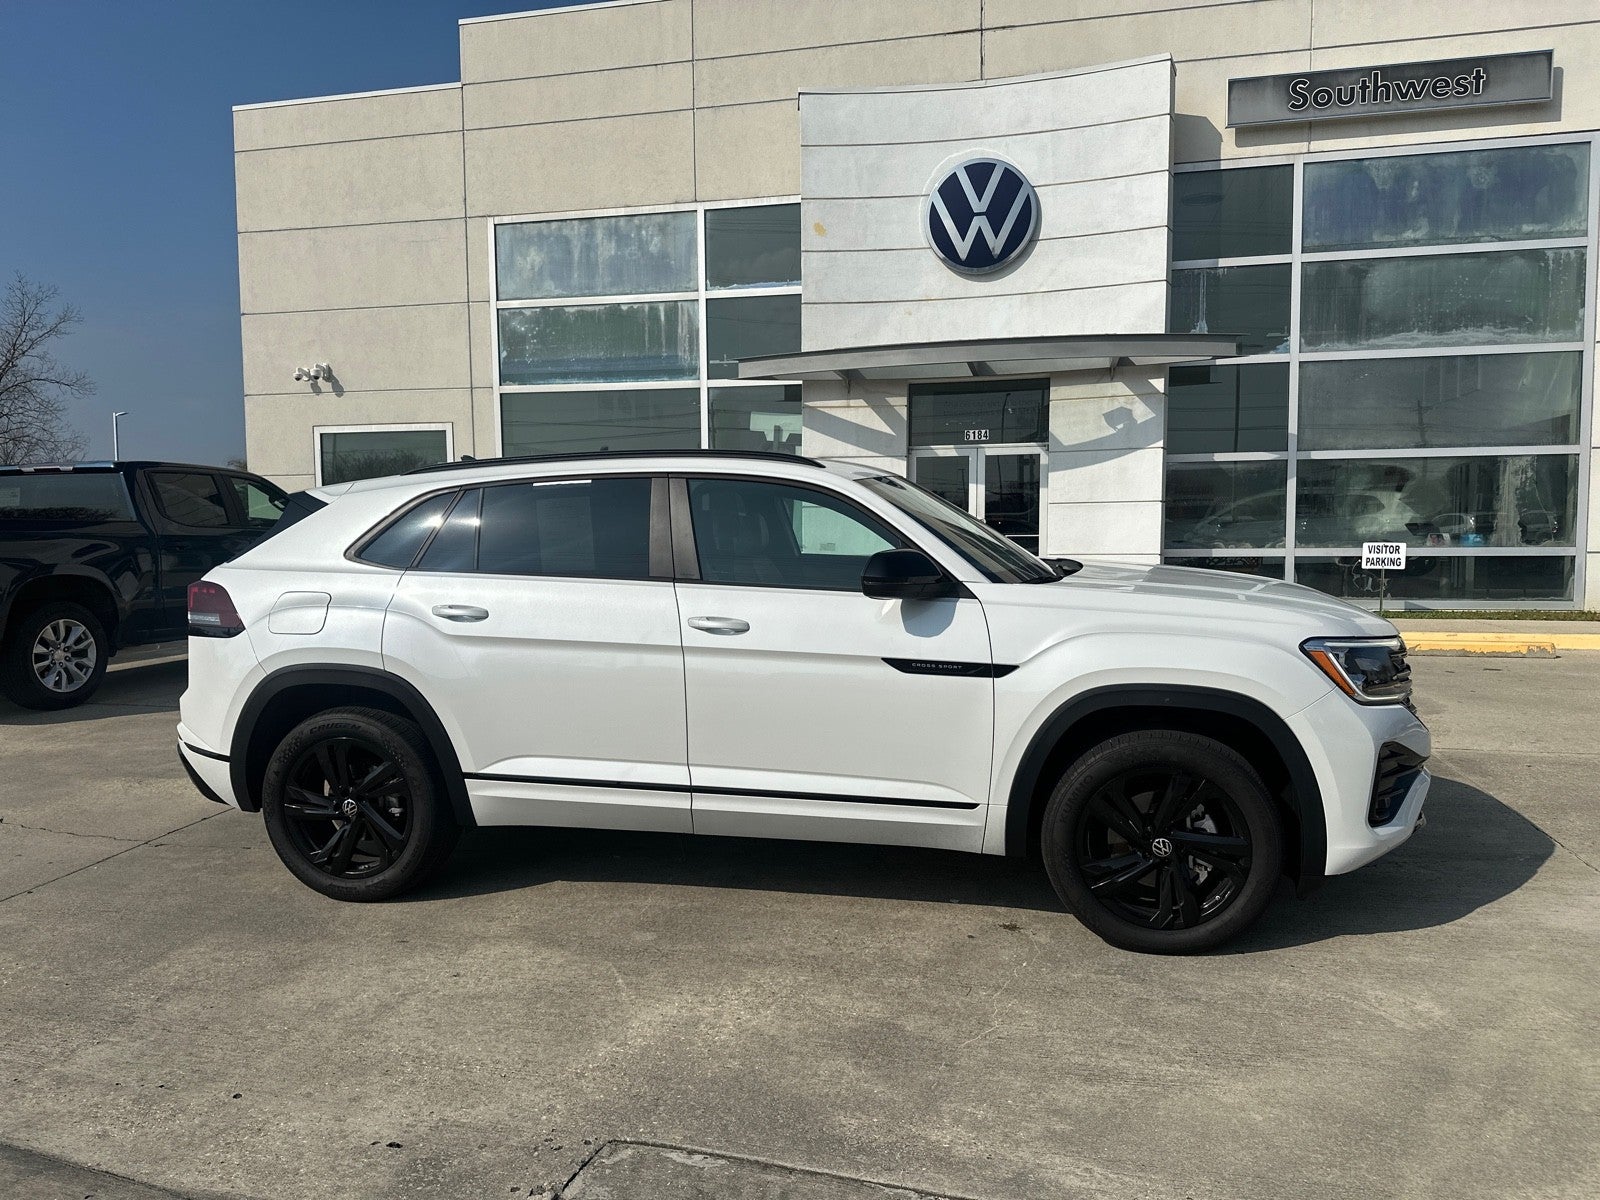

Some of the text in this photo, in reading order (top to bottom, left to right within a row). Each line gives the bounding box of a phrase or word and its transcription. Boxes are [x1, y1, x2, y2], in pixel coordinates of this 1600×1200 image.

[1288, 67, 1486, 111] Southwest
[926, 158, 1037, 271] VW
[965, 430, 988, 440] 6184
[1368, 545, 1400, 554] VISITOR
[1366, 557, 1401, 566] PARKING
